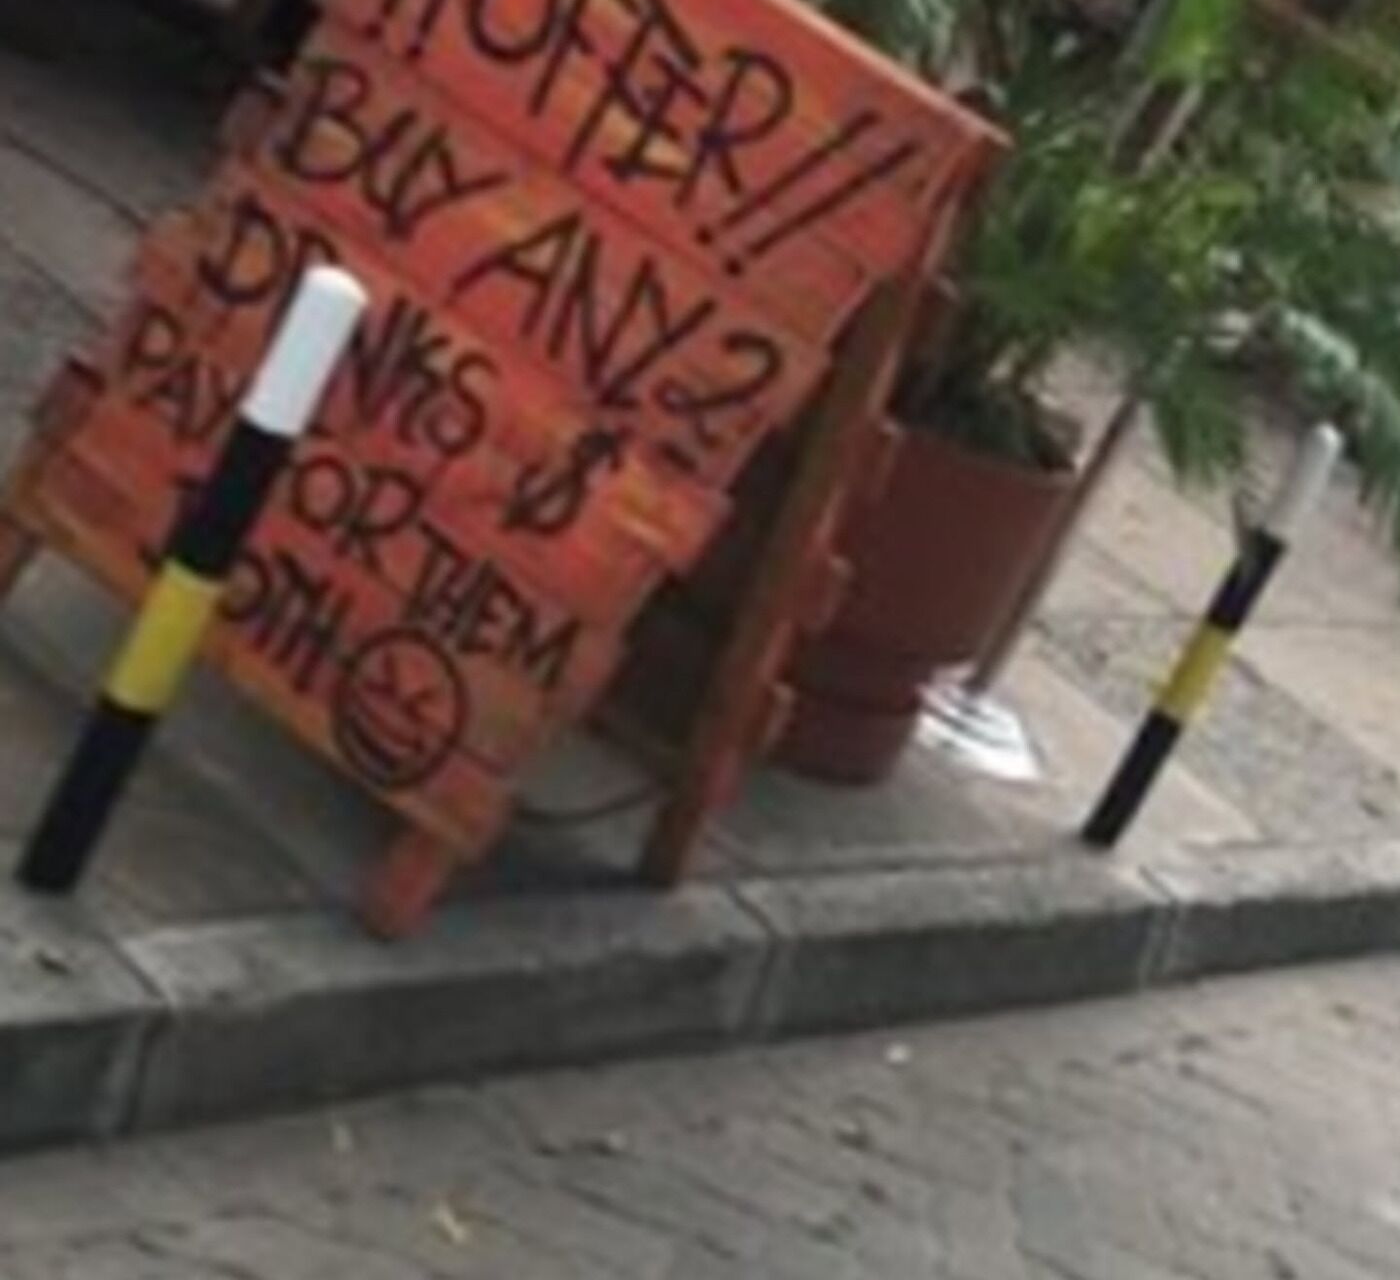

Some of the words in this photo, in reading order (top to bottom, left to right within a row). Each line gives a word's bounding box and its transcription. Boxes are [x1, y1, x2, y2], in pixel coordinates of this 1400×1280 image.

[280, 59, 508, 243] BUY
[445, 213, 717, 410] ANY
[651, 331, 783, 425] 2
[406, 522, 583, 690] THEM
